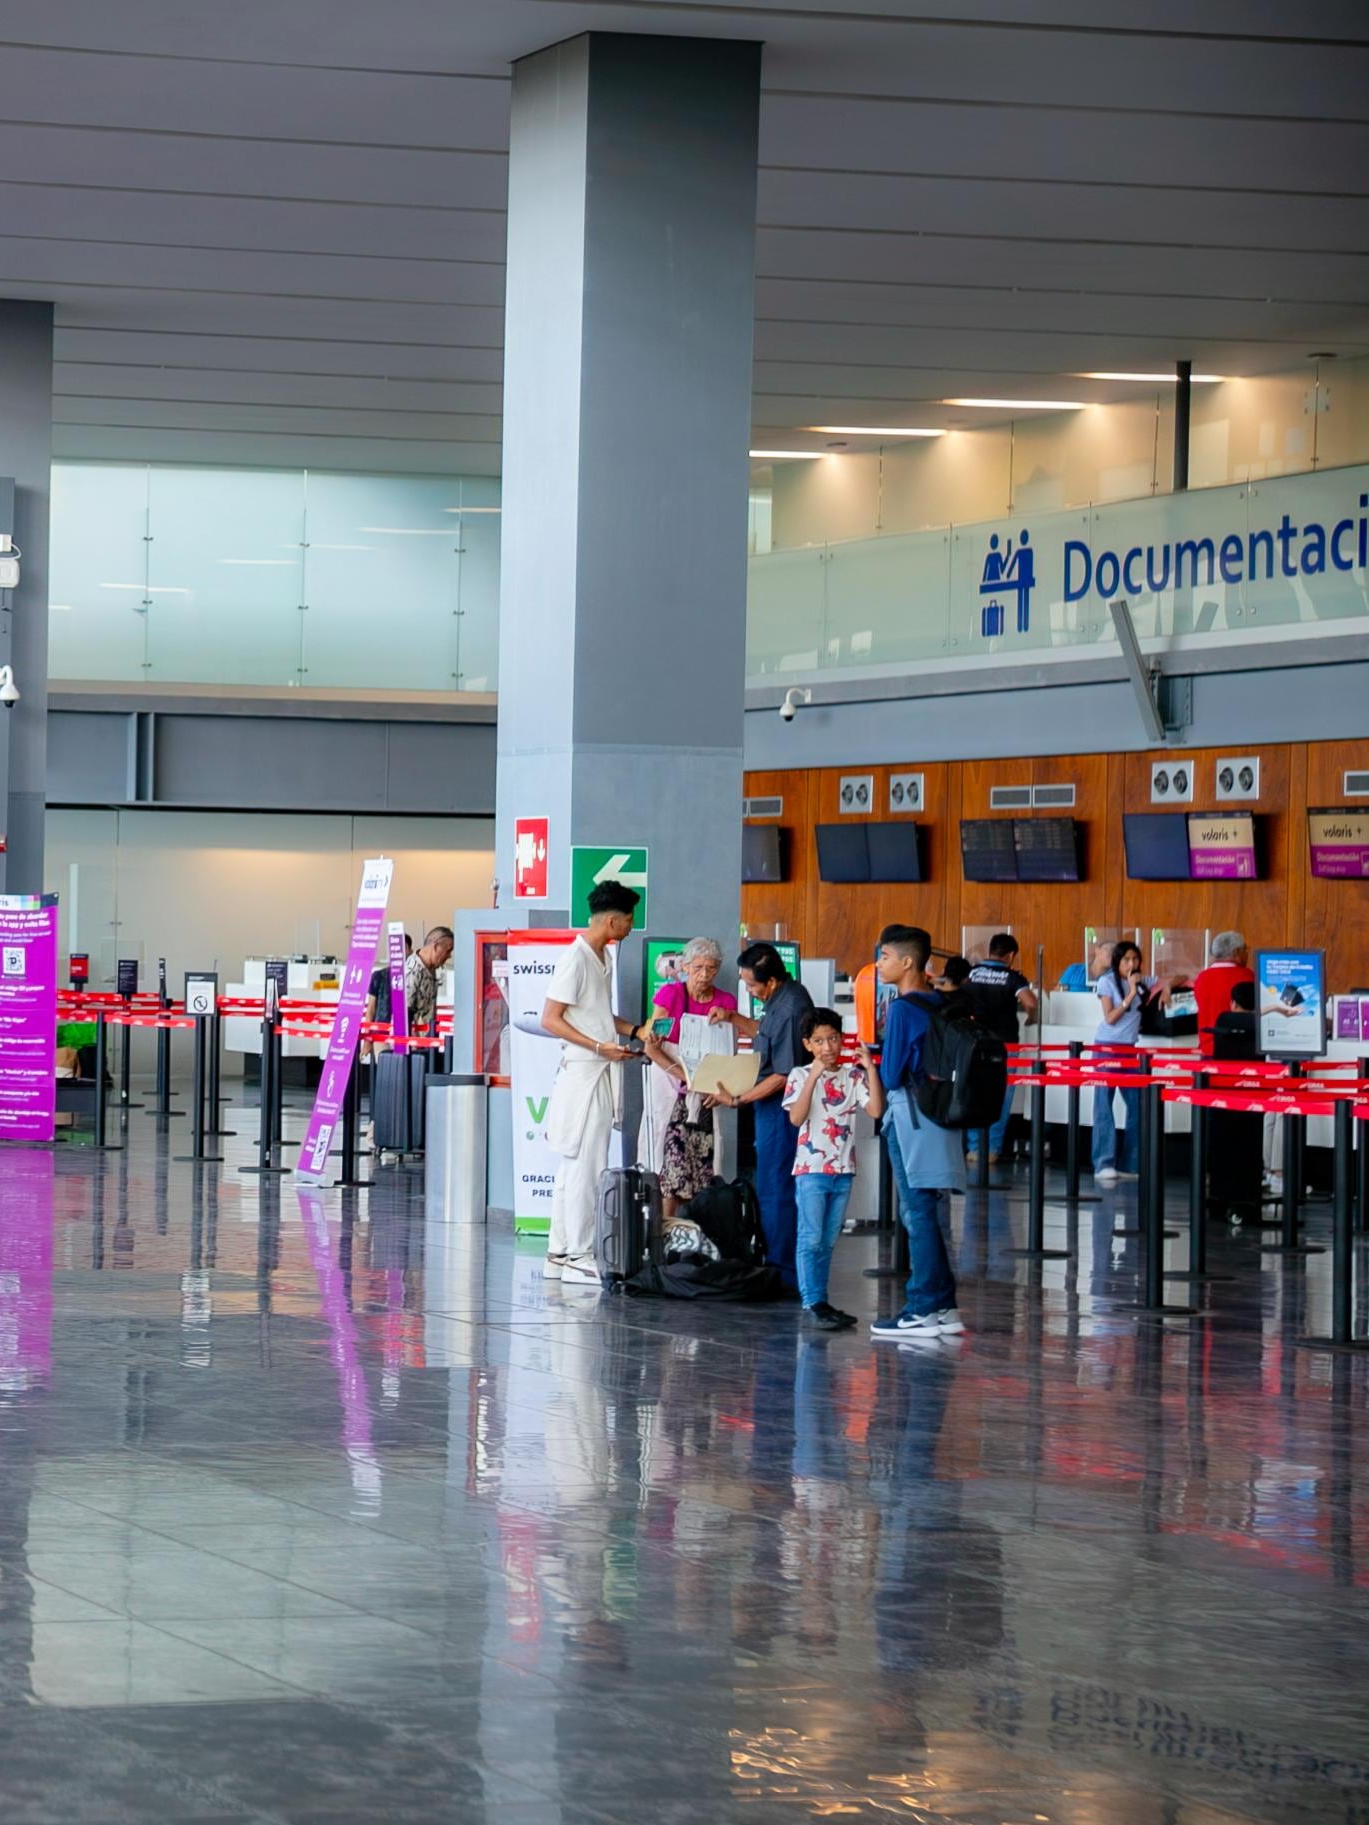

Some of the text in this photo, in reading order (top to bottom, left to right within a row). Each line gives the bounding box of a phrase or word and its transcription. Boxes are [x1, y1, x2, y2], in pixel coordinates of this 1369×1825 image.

[1064, 493, 1368, 602] Documentaci
[526, 1096, 550, 1124] V
[522, 1174, 555, 1183] GRACI
[532, 1189, 553, 1198] PRE
